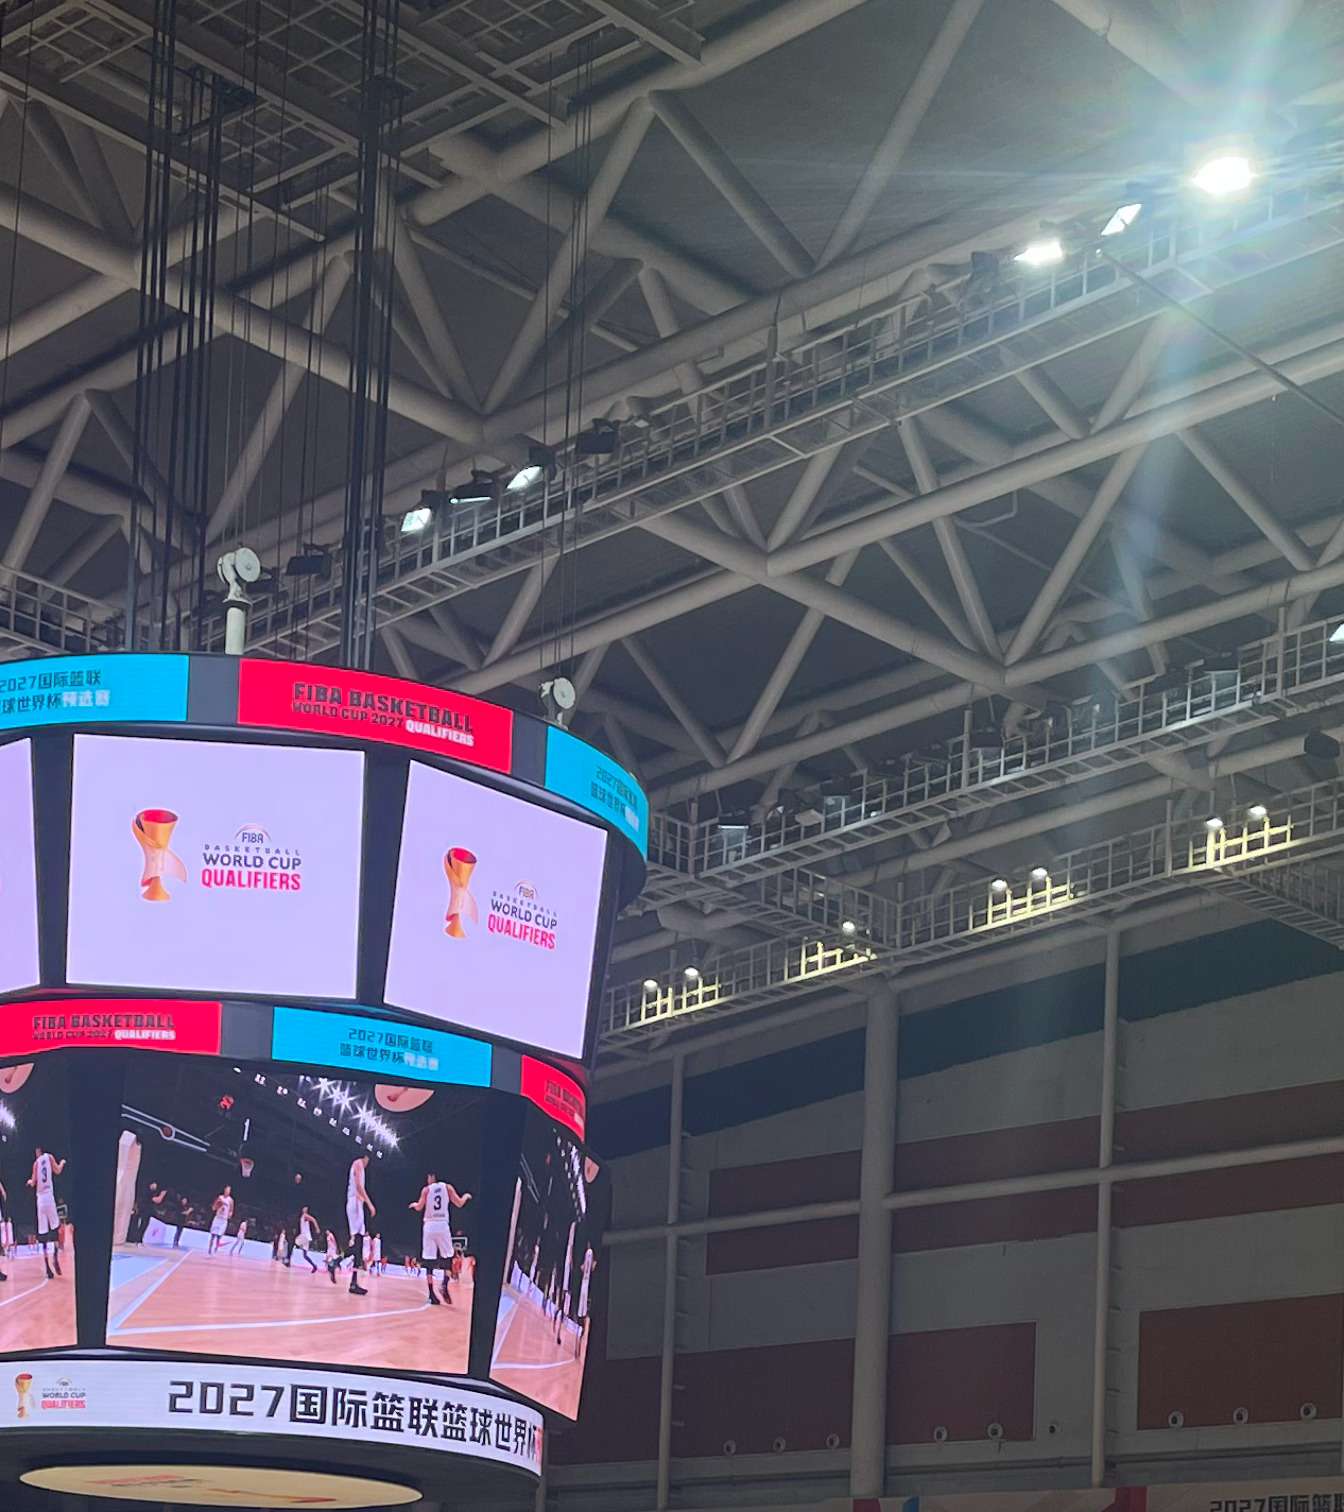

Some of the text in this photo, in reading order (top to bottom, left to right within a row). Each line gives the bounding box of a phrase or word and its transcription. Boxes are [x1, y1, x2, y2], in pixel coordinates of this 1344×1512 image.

[293, 682, 474, 732] FIBA BASKETBALL
[292, 702, 474, 747] WORLD CUP 2027 QUALIFIERS
[242, 831, 264, 843] FIBA
[204, 844, 301, 856] BASKETBALL
[202, 853, 302, 870] WORLD CUP
[201, 868, 302, 891] QUALIFIERS
[491, 898, 558, 930] WORLD CUP
[487, 913, 556, 950] QUALIFIERS
[33, 1014, 176, 1030] FIBA BASKETBALL
[114, 1029, 176, 1041] QUALIFIERS
[433, 1195, 442, 1211] 3
